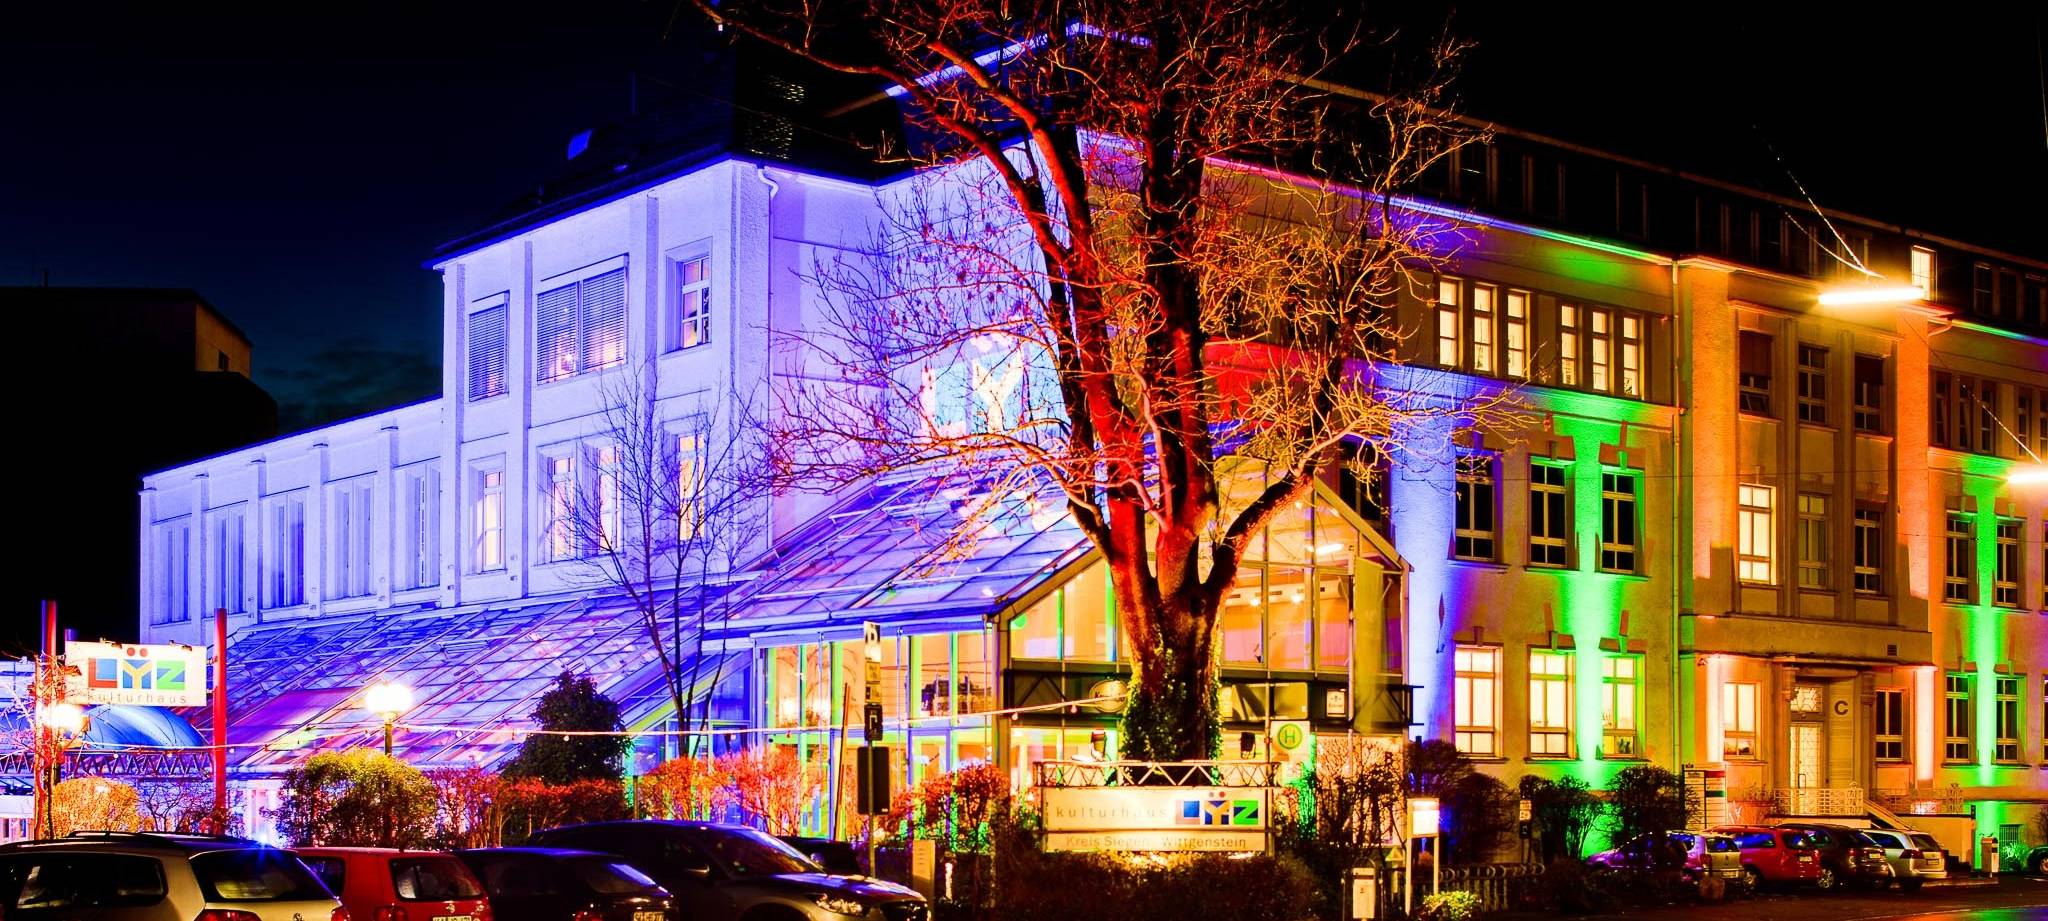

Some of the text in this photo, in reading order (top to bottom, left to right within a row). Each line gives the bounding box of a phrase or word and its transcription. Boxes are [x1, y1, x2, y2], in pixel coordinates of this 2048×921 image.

[88, 692, 187, 704] kulturhaus
[1834, 700, 1848, 715] C
[1284, 729, 1296, 743] H
[1056, 806, 1167, 818] kulturhaus
[1066, 836, 1247, 848] Kreis Siegen Wittgenstein
